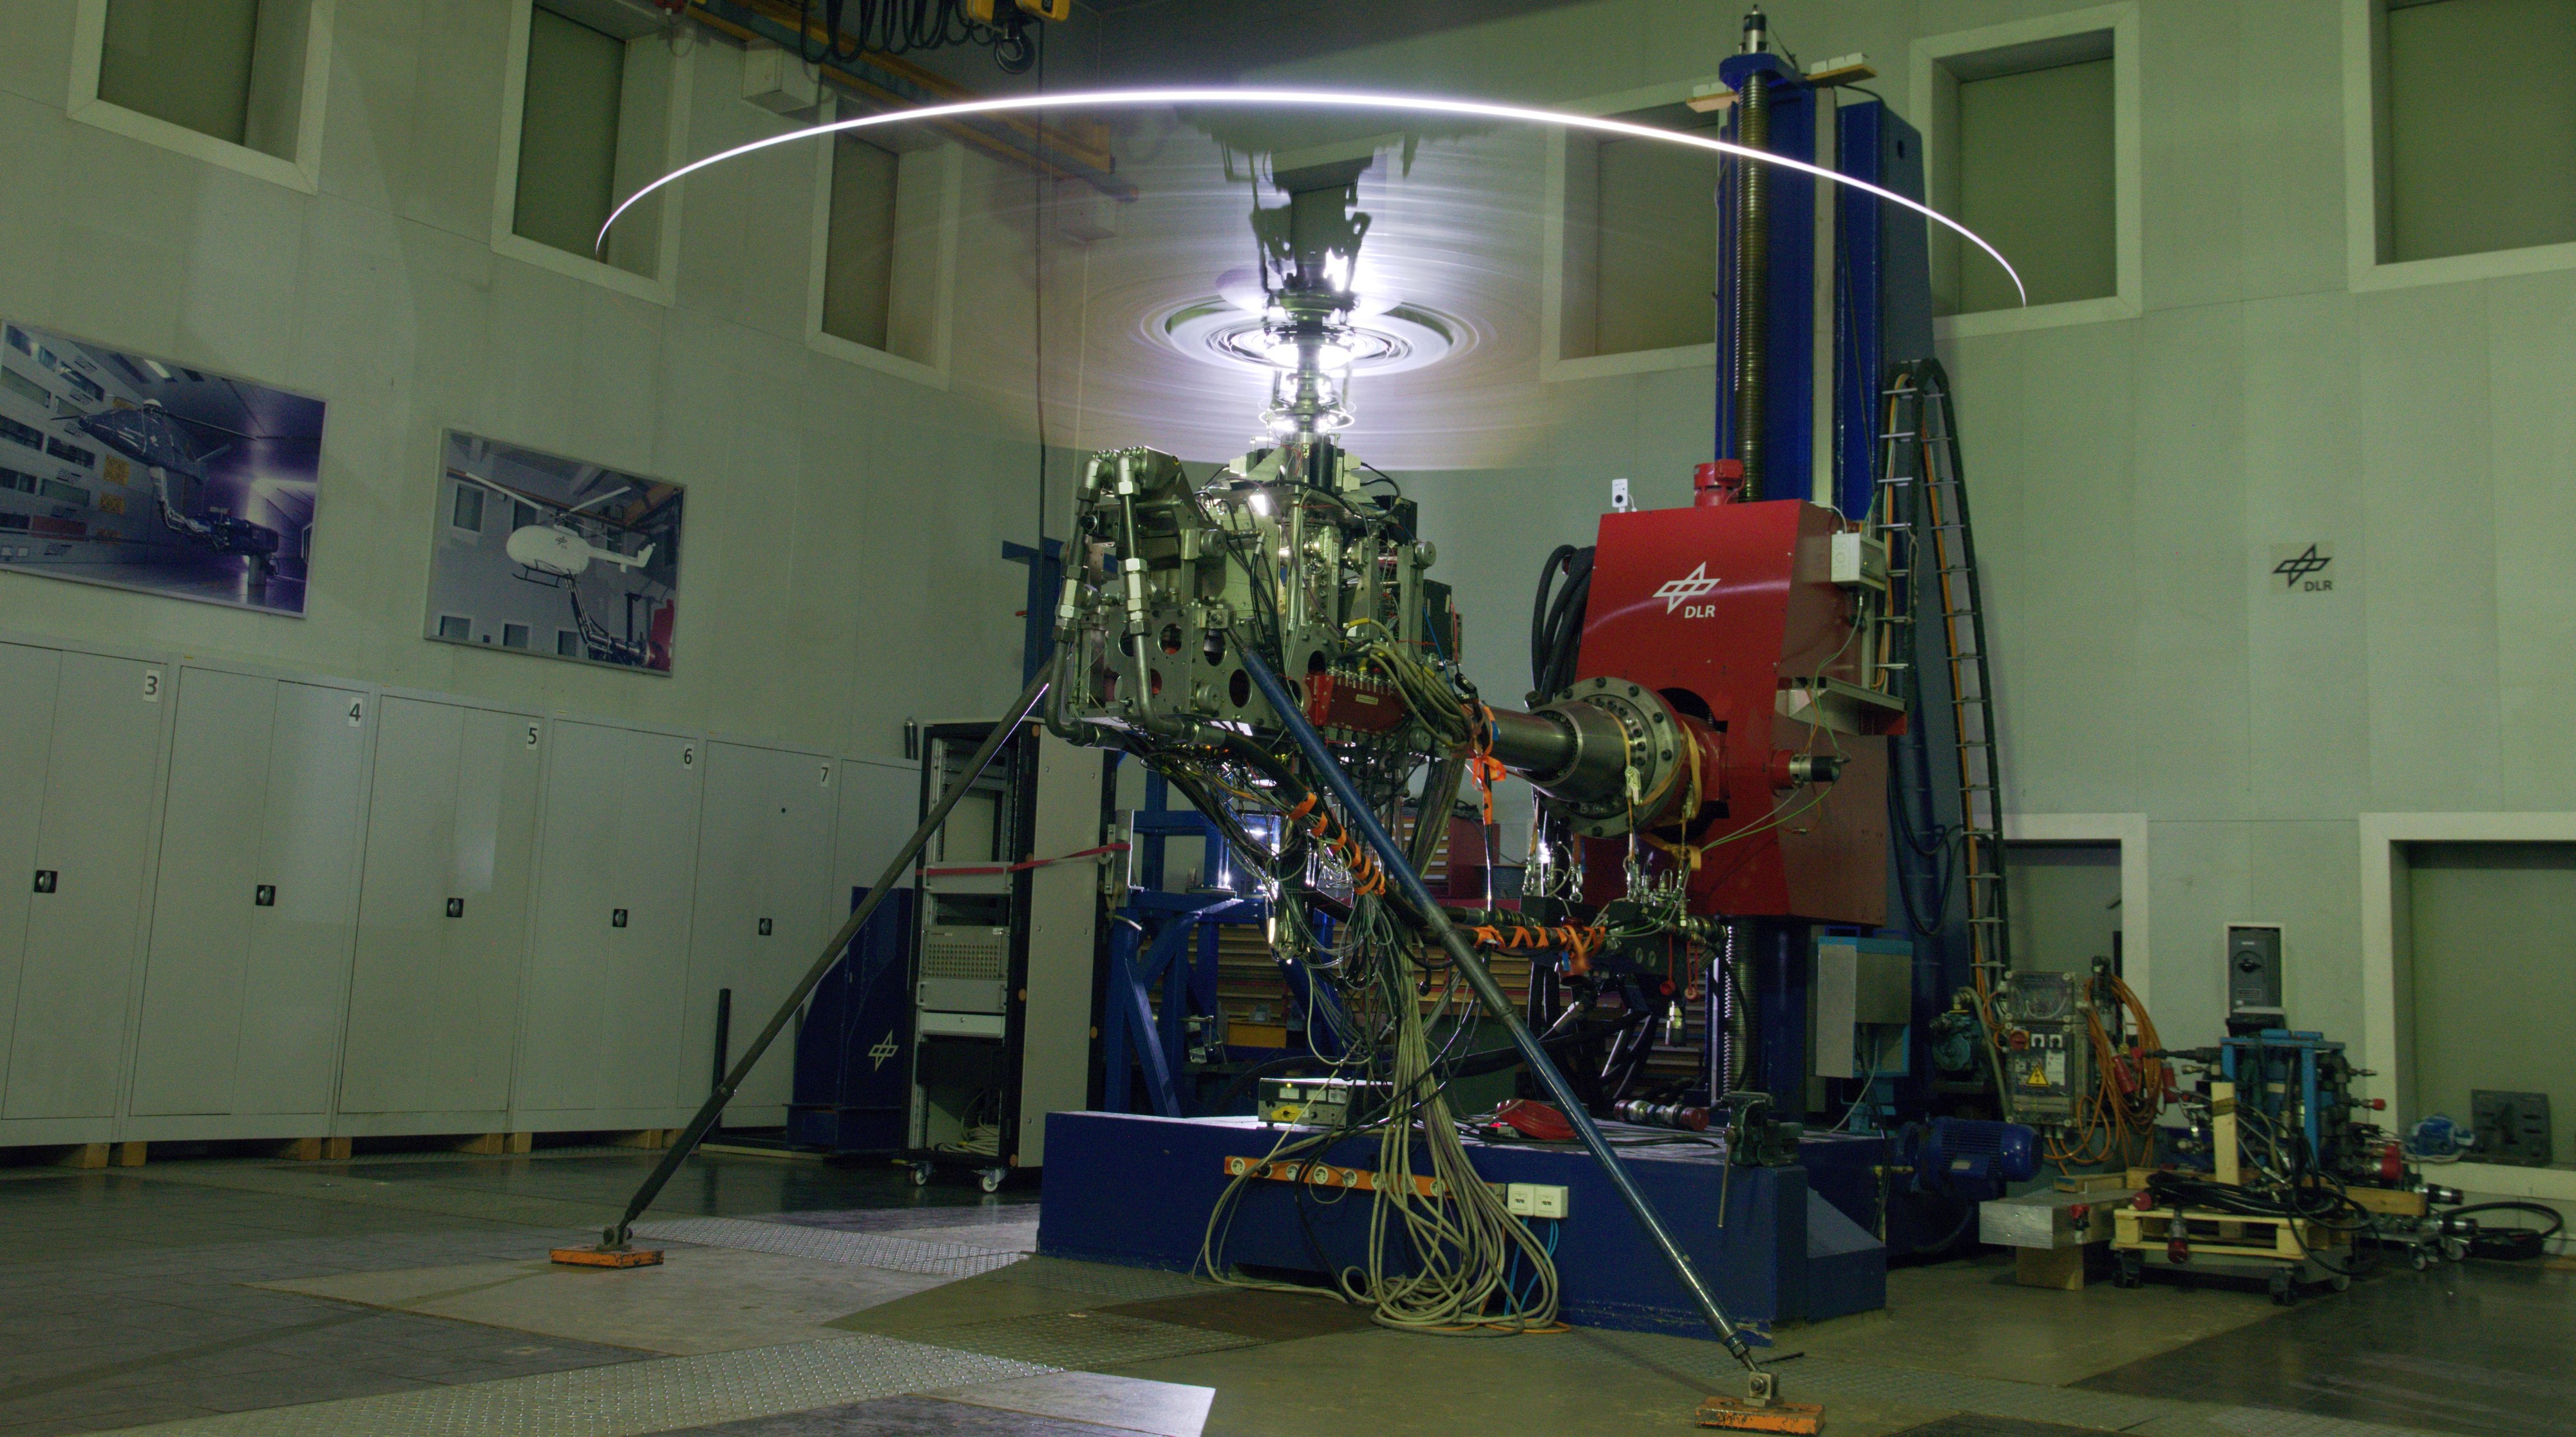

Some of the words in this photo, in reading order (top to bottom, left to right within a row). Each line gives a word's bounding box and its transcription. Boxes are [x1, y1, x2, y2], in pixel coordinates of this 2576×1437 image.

[2304, 580, 2333, 592] DLR
[1684, 605, 1716, 619] DLR
[145, 675, 158, 695] 3
[349, 703, 361, 722] 4
[527, 727, 538, 745] 5
[683, 748, 692, 765] 6
[821, 766, 829, 782] 7
